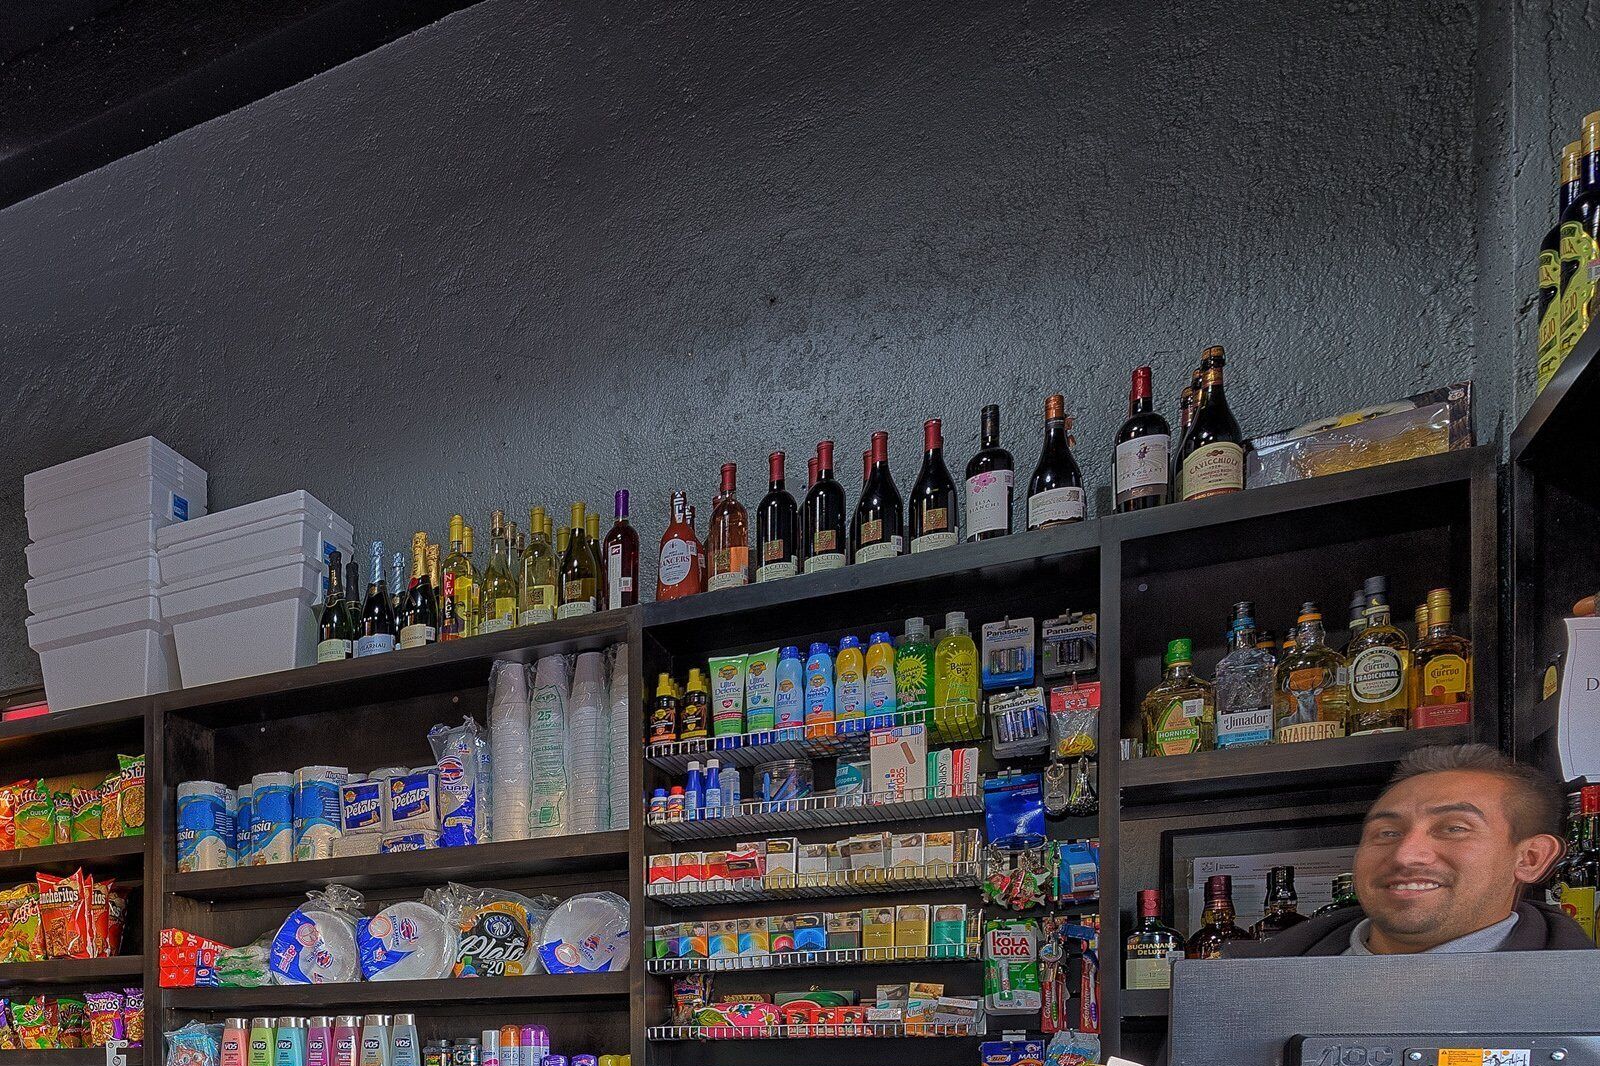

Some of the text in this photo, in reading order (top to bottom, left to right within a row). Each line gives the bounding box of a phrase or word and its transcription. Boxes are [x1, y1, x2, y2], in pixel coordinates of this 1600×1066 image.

[445, 572, 454, 619] NEW AGE
[986, 627, 1029, 637] Panasonic
[1046, 624, 1093, 635] Panasonic
[1356, 671, 1398, 682] TRADICIONAL
[715, 686, 741, 695] Defense
[778, 693, 790, 702] Dry
[993, 697, 1038, 711] Panasonic
[537, 710, 552, 721] 25
[1226, 714, 1268, 730] Jimador
[1158, 728, 1196, 739] HORNITOS
[993, 931, 1029, 947] KOLA
[459, 934, 527, 962] Plato
[993, 944, 1030, 956] LOKA
[488, 961, 505, 975] 20
[89, 999, 120, 1012] OSTITOS
